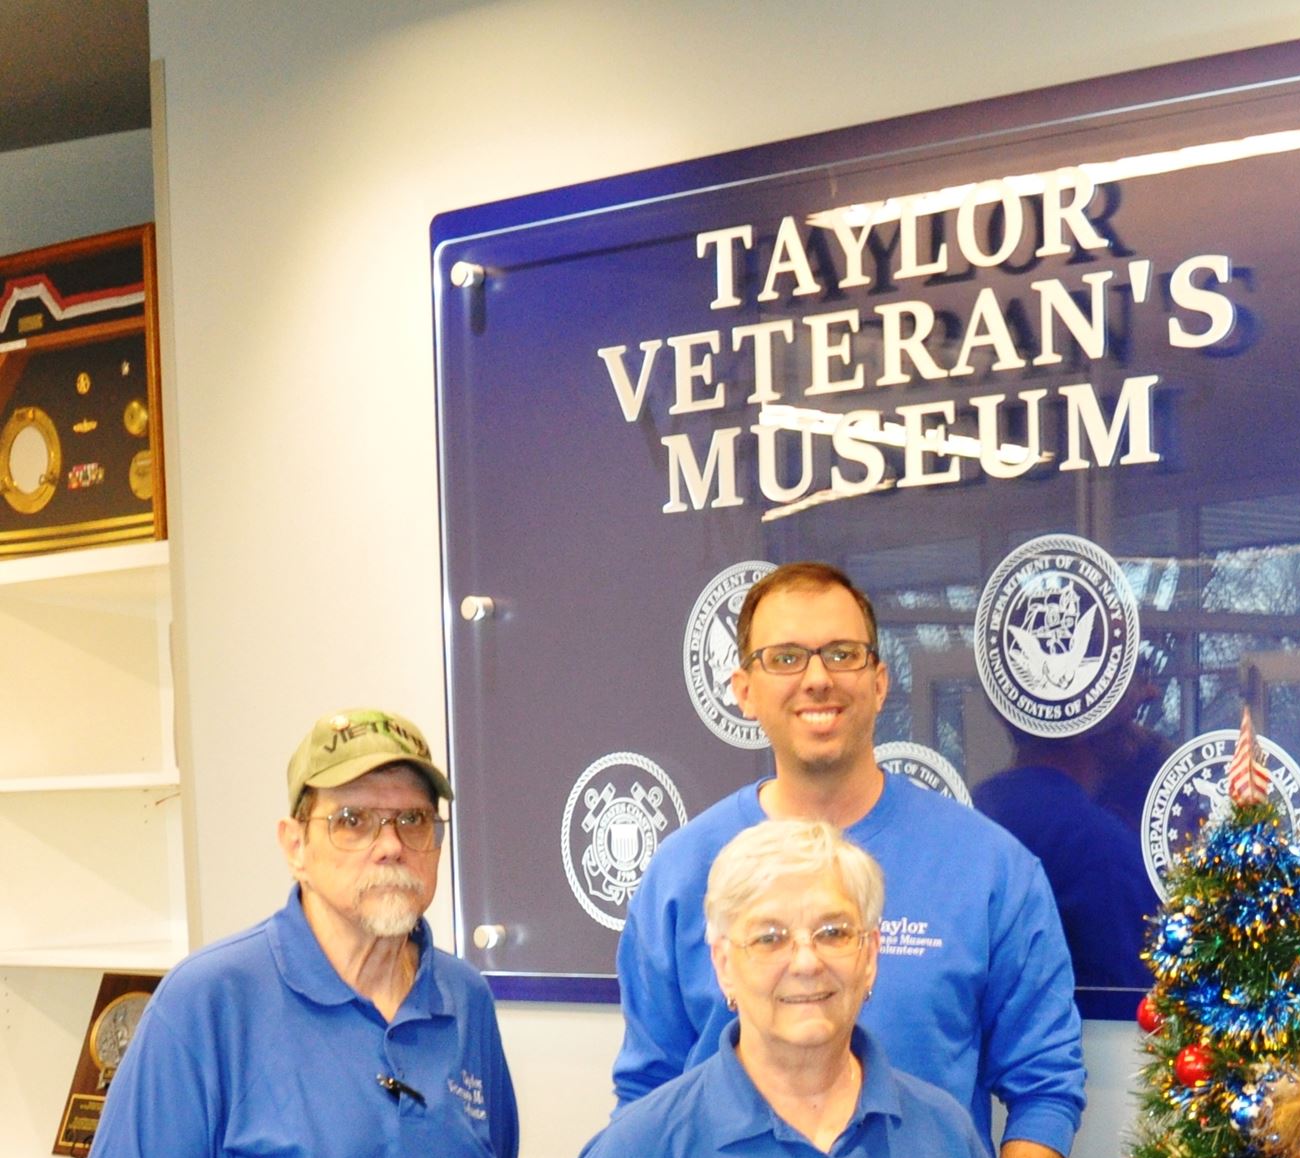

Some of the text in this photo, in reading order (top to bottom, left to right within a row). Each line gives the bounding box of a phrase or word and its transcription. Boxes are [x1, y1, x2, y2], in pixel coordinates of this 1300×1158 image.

[697, 165, 1109, 311] TAYLOR
[597, 254, 1237, 423] VETERAN'S
[662, 374, 1164, 514] MUSEUM
[690, 571, 747, 652] DEPARTMENT
[989, 555, 1123, 631] DEPARTMENT OF THE NAVY
[691, 664, 719, 720] UNITED
[989, 644, 1123, 719] UNITED STATES OF AMERICA
[904, 761, 920, 776] OF
[920, 766, 940, 789] THE
[1150, 752, 1196, 870] DEPARTMENT
[1201, 740, 1226, 760] OF
[1272, 765, 1300, 800] AIR
[878, 916, 929, 936] aylor
[879, 945, 925, 956] olunteer
